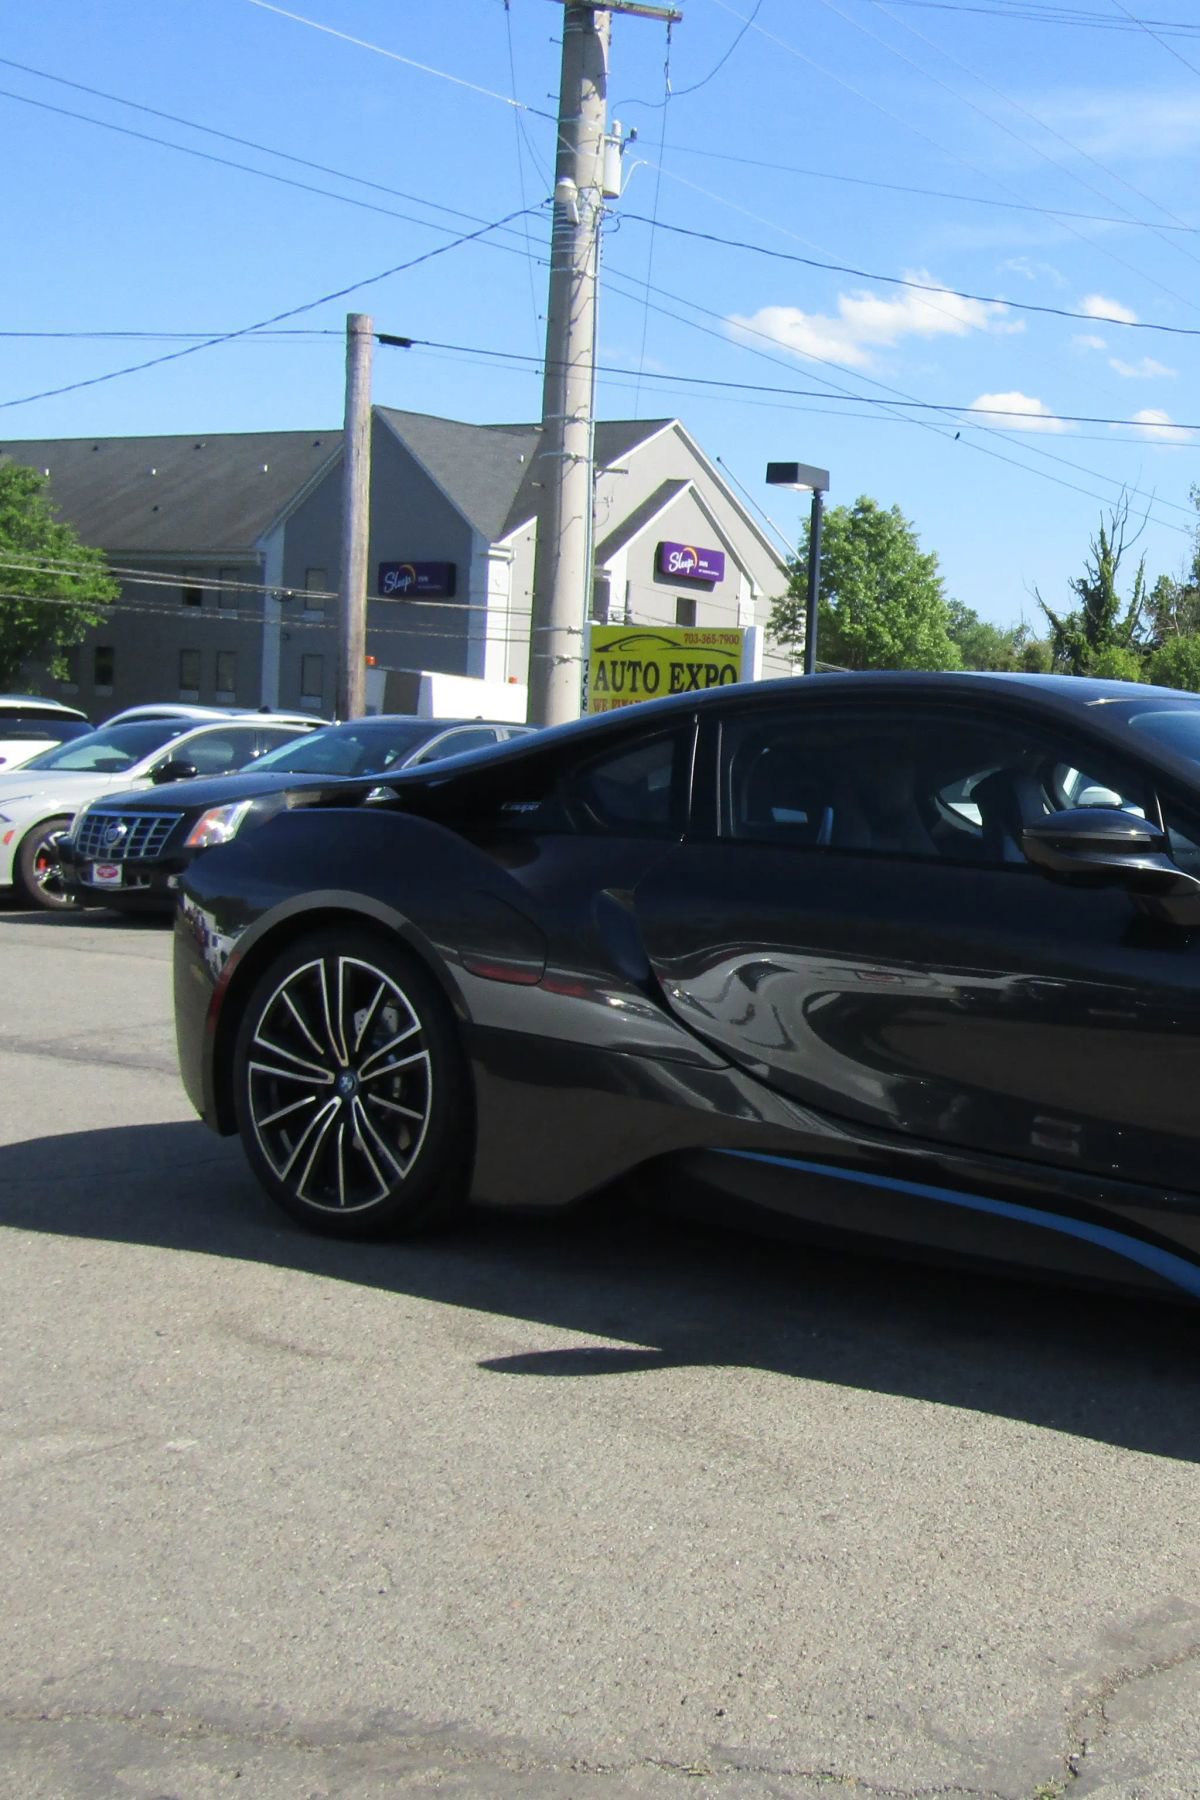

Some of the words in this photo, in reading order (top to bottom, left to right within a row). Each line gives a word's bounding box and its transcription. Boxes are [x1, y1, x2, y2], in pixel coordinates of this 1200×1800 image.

[668, 551, 695, 574] Sleep
[683, 632, 741, 646] 703-365-7900
[593, 660, 661, 694] AUTO
[668, 662, 738, 694] EXPO
